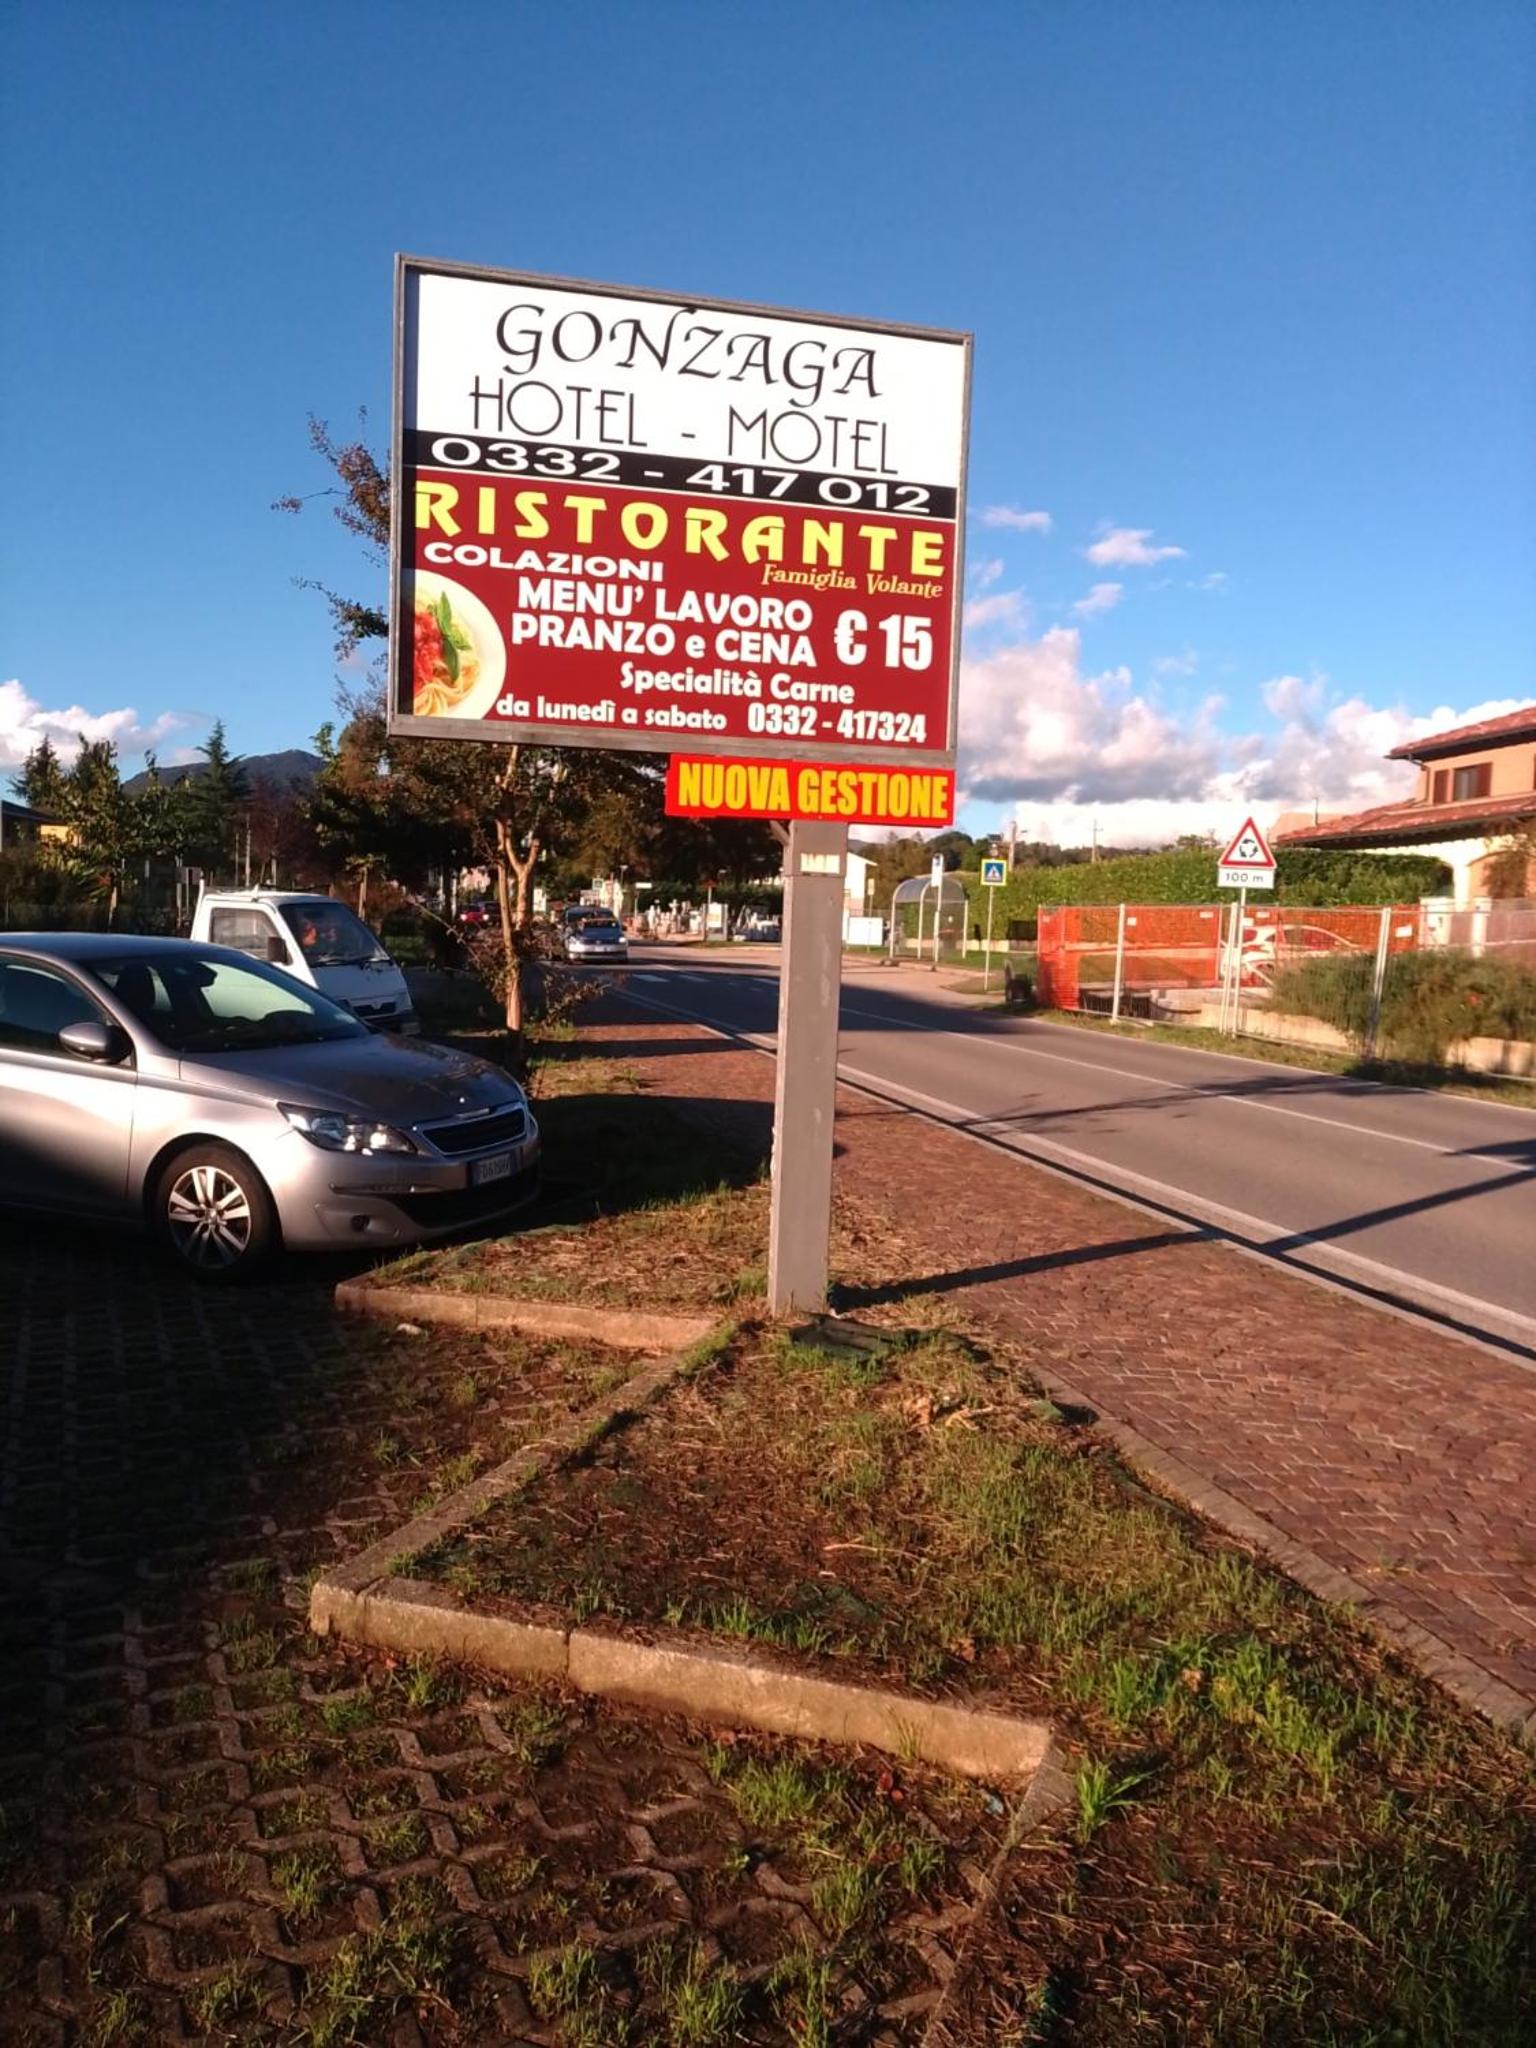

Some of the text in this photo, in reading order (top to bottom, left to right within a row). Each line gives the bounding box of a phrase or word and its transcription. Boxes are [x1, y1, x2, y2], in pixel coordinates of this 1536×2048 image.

[496, 304, 883, 408] GONZAGA
[469, 375, 648, 447] HOTEL
[728, 404, 898, 475] MOTEL
[431, 437, 621, 481] 0332
[685, 464, 799, 498] 417
[818, 477, 931, 514] 012
[414, 480, 945, 578] RISTORANTE
[423, 542, 664, 582] COLAZIONI
[761, 563, 943, 599] Famiglia Volante
[655, 588, 813, 632] LAVORO
[511, 612, 817, 668] PRANZO e CENA
[834, 609, 933, 671] € 15
[620, 660, 856, 704] Specialità Carne
[496, 693, 728, 730] da lunedì a sabato
[748, 702, 818, 736] 0332
[836, 708, 927, 743] 417324
[678, 761, 949, 819] NUOVA GESTIONE
[1225, 872, 1264, 883] 100 m
